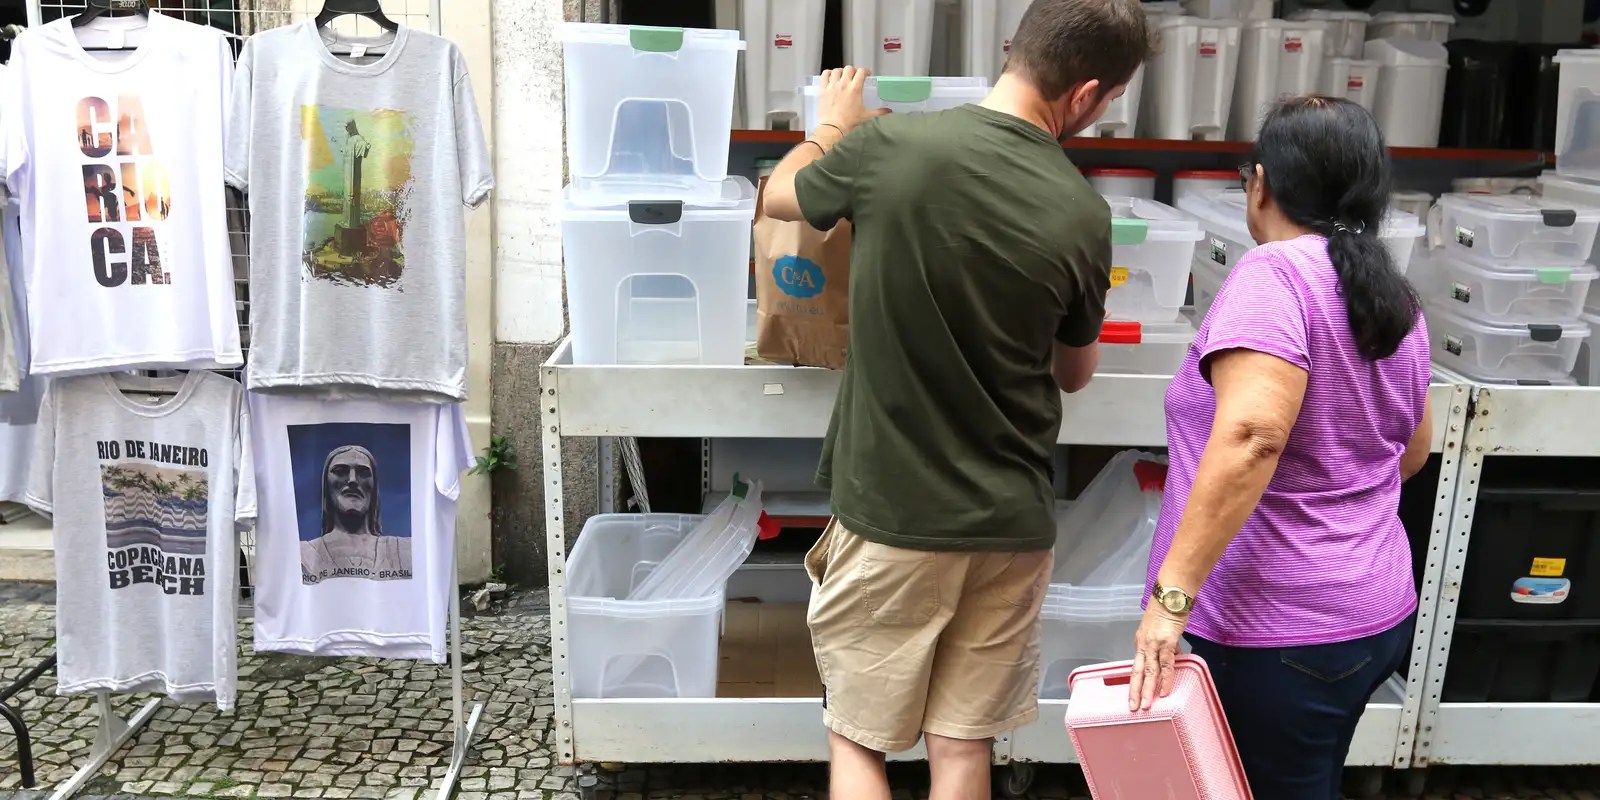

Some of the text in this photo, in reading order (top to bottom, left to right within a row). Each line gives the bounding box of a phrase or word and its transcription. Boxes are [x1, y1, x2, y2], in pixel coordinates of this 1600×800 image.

[77, 93, 154, 158] CA
[82, 161, 172, 223] RIO
[781, 266, 816, 289] C&A
[97, 440, 209, 468] RIO DE JANEIRO
[108, 565, 206, 596] BEACH
[302, 574, 317, 583] RIO
[331, 567, 370, 576] JANEIRO
[379, 569, 412, 579] BRASIL
